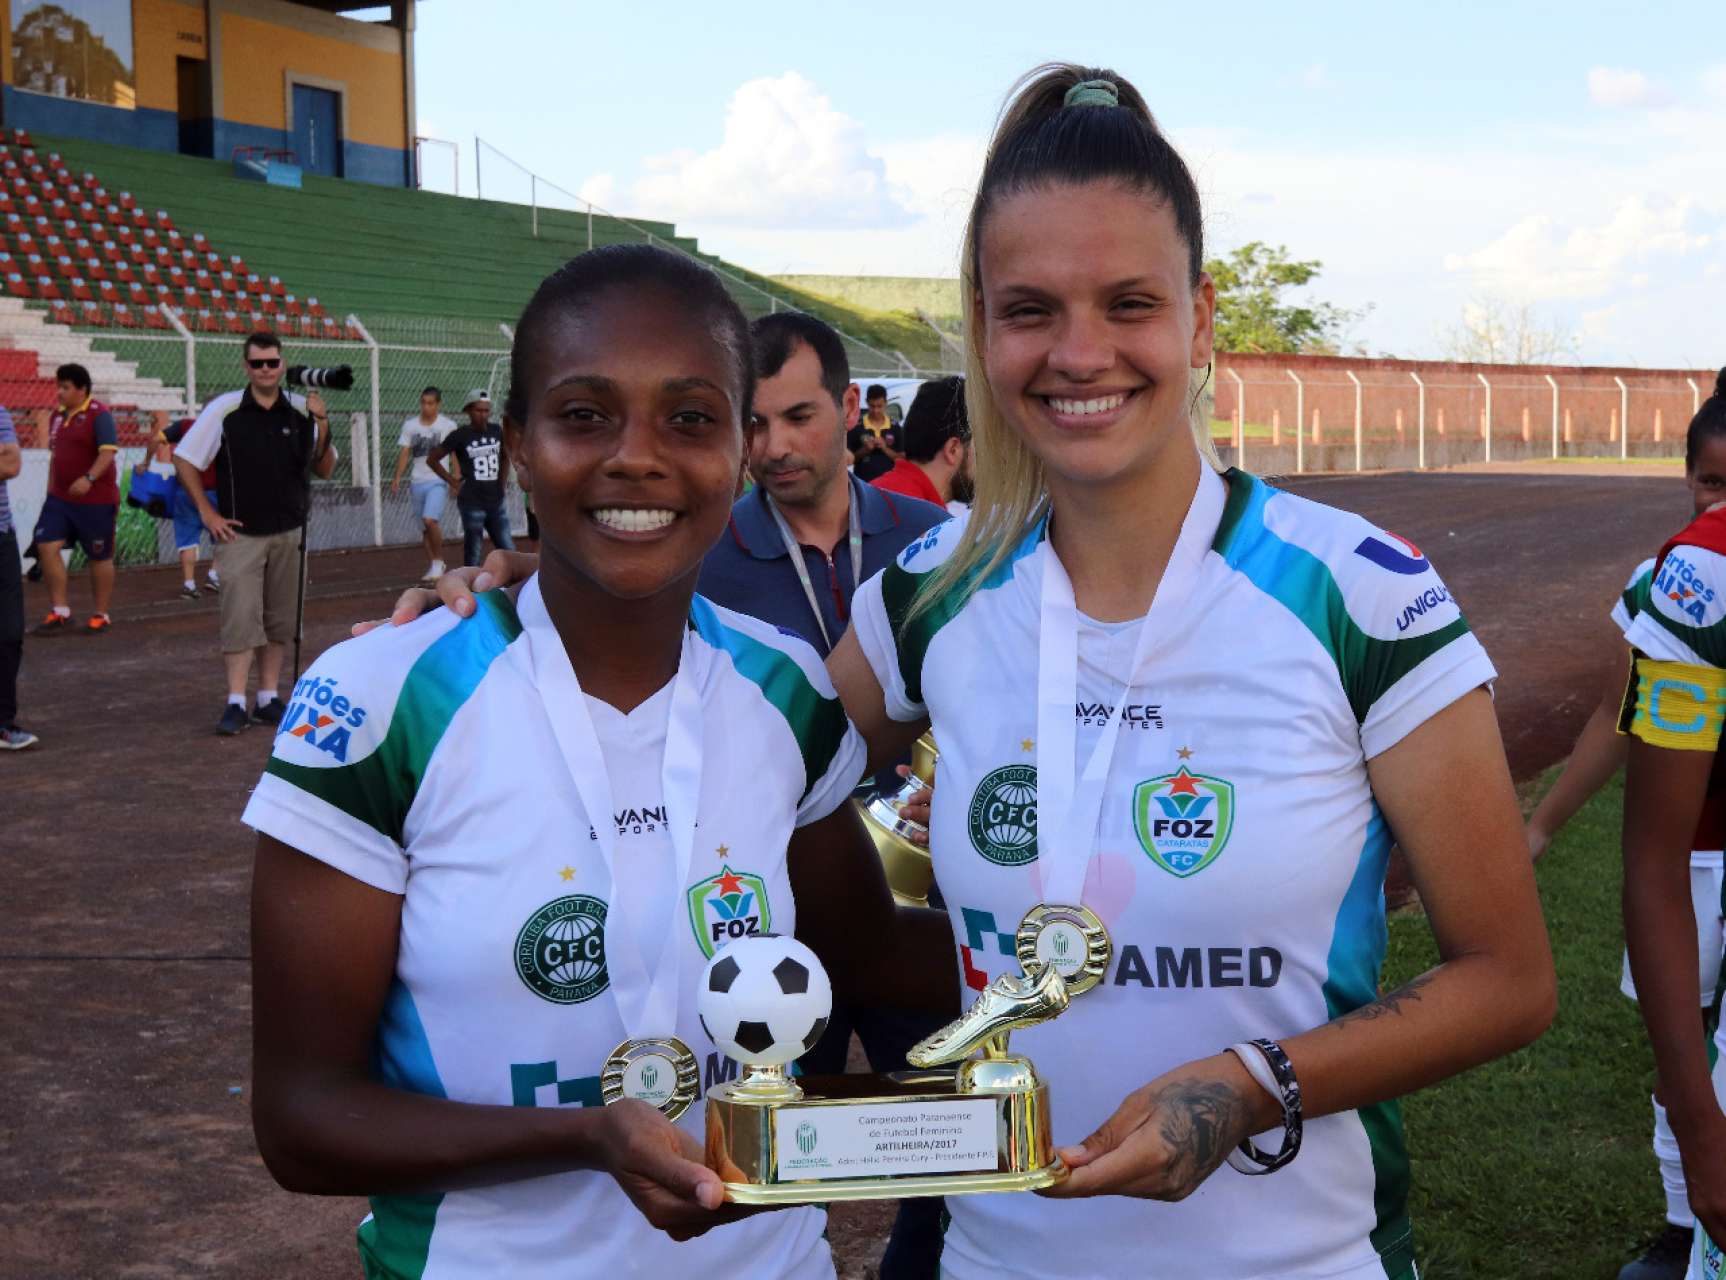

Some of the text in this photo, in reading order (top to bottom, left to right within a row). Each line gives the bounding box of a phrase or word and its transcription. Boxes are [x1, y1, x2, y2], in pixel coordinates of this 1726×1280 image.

[1655, 567, 1706, 626] AIXA
[1650, 676, 1706, 733] C
[1003, 768, 1033, 780] FOOT
[1153, 819, 1214, 838] FOZ
[1156, 840, 1209, 848] CATARATAS
[1171, 854, 1193, 866] FC
[520, 900, 606, 974] CORITIBA FOOT BA
[711, 916, 760, 942] FOZ
[1100, 944, 1282, 988] AMED
[858, 1112, 972, 1126] Campeonato Paranaense
[869, 1126, 963, 1138] de Futebol Feminino
[875, 1139, 957, 1152] ARTILHEIRA/2017
